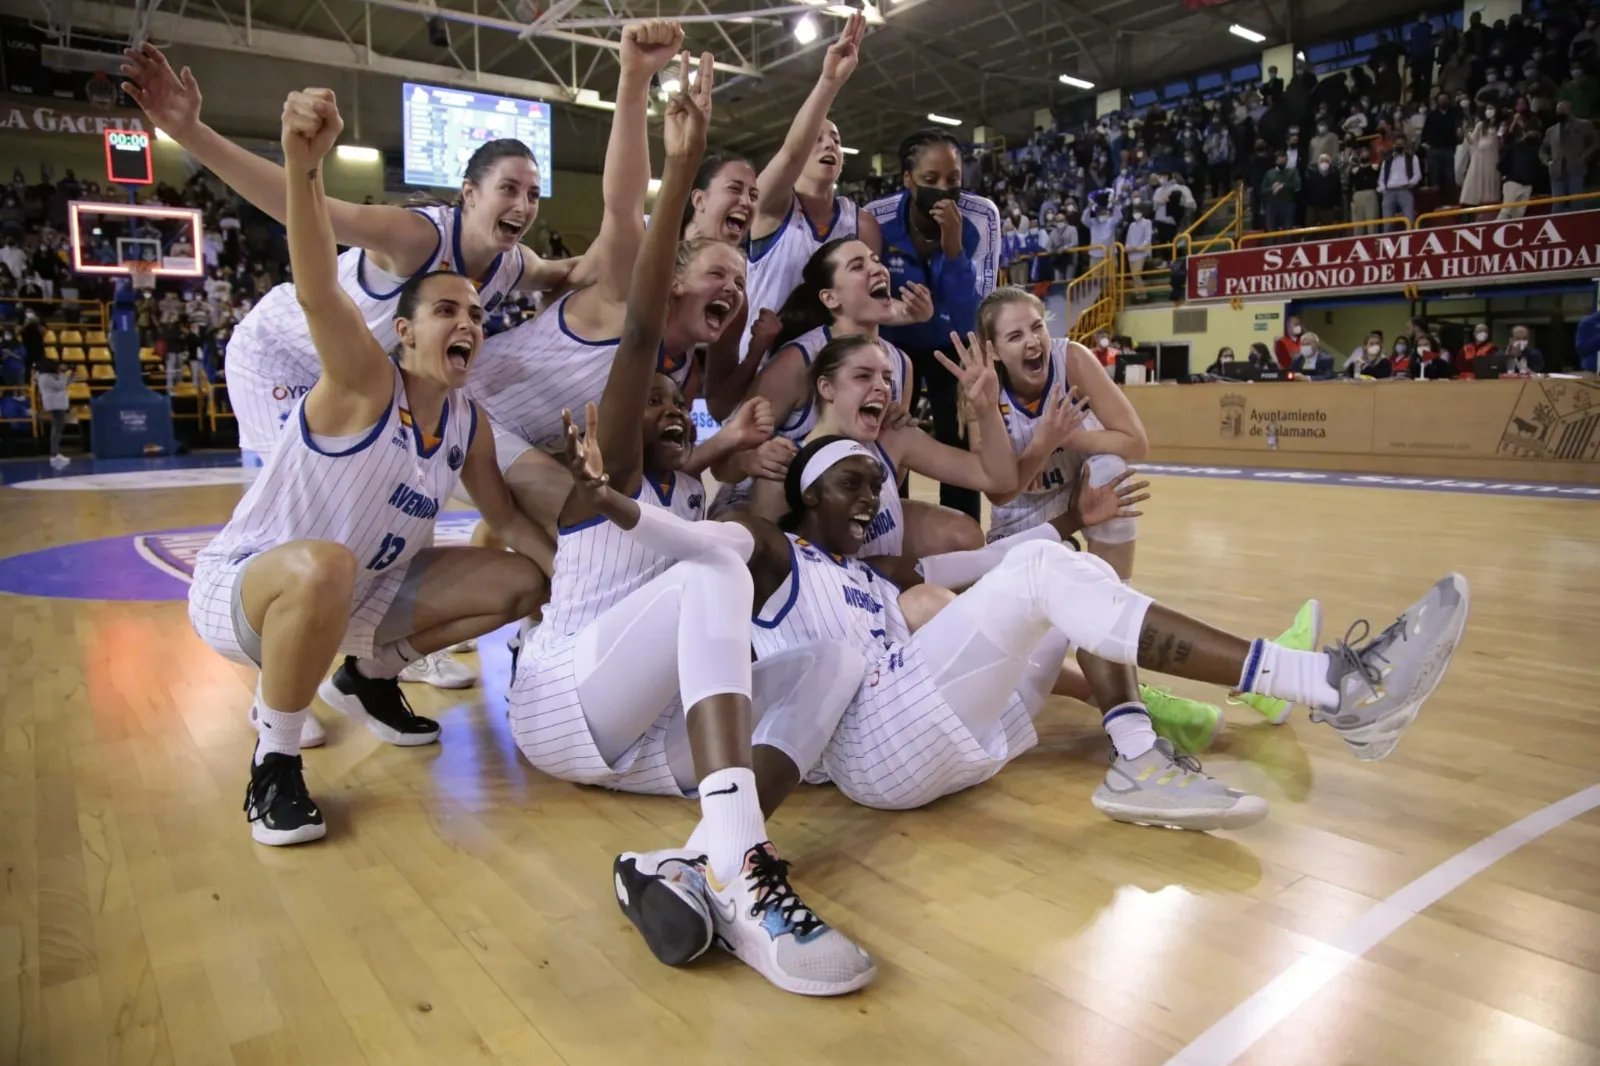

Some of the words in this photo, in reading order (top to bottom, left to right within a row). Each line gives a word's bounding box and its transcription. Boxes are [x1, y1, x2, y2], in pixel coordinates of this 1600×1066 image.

[33, 107, 144, 134] GACETA
[109, 132, 148, 148] 00:00
[1263, 219, 1567, 272] SALAMANCA
[1225, 266, 1356, 295] PATRIMONIO
[1363, 263, 1395, 284] DE
[1403, 259, 1433, 281] LA
[1250, 408, 1327, 424] Ayuntamiento
[1250, 425, 1262, 436] de
[366, 532, 406, 571] 13
